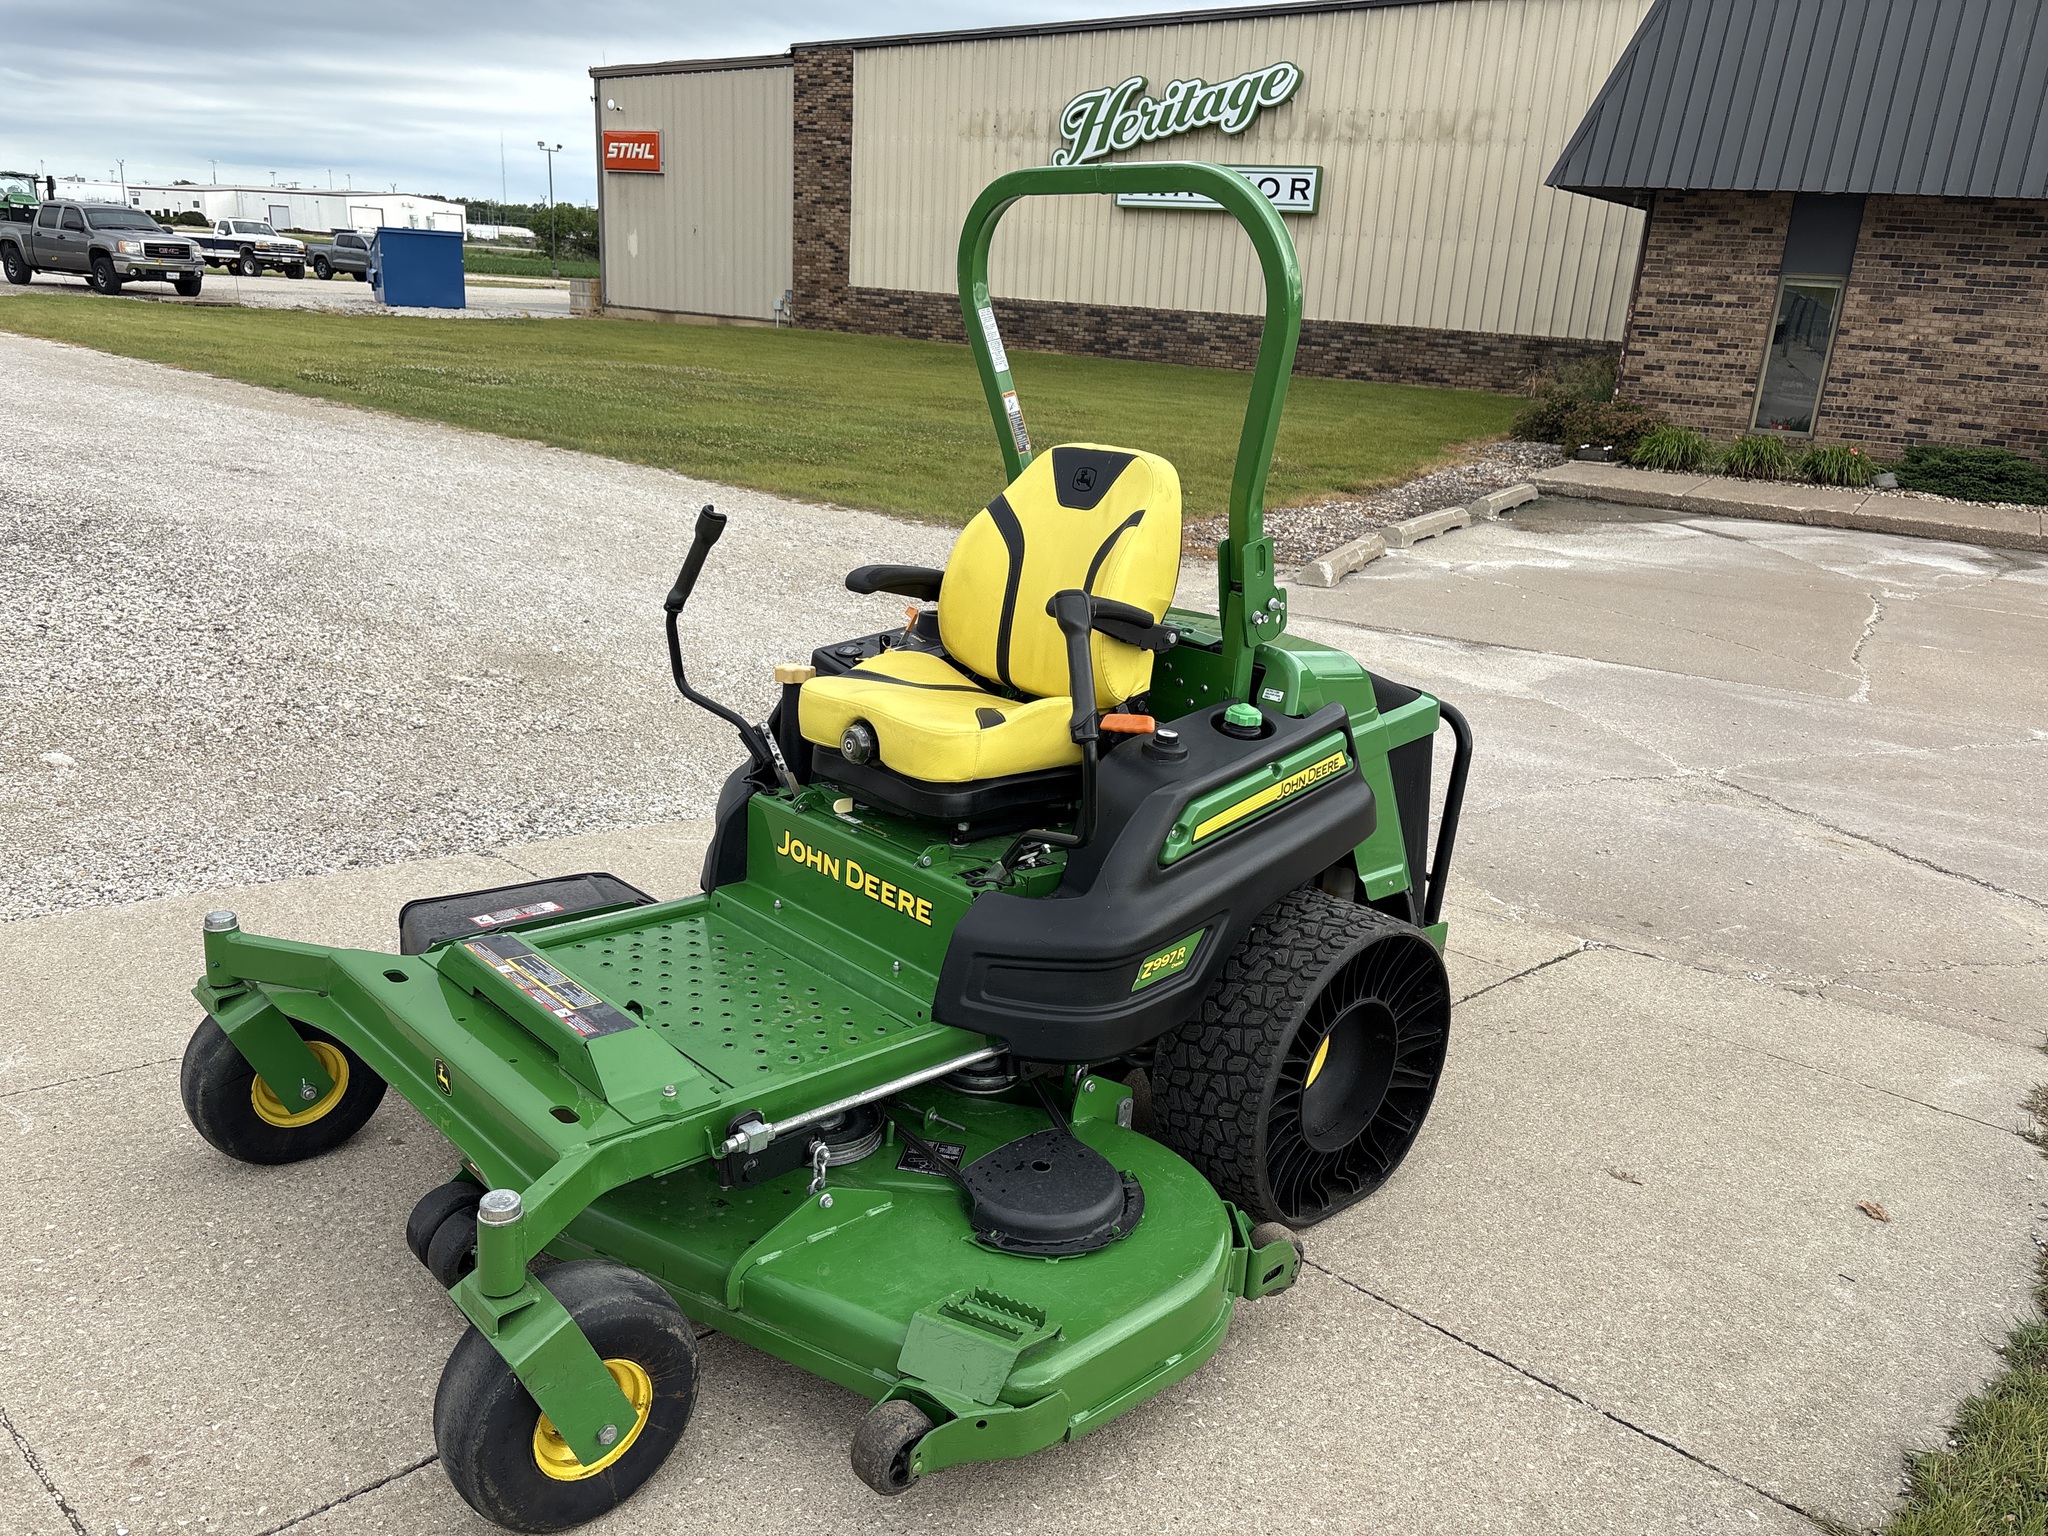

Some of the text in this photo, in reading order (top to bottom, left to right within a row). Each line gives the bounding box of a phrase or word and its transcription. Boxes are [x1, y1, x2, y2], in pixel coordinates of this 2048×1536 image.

[1053, 63, 1301, 166] Heritage
[606, 142, 655, 160] STIHL
[1276, 757, 1340, 799] JOHN DEERE
[776, 830, 934, 927] JOHN DEERE
[1140, 945, 1187, 980] Z997R
